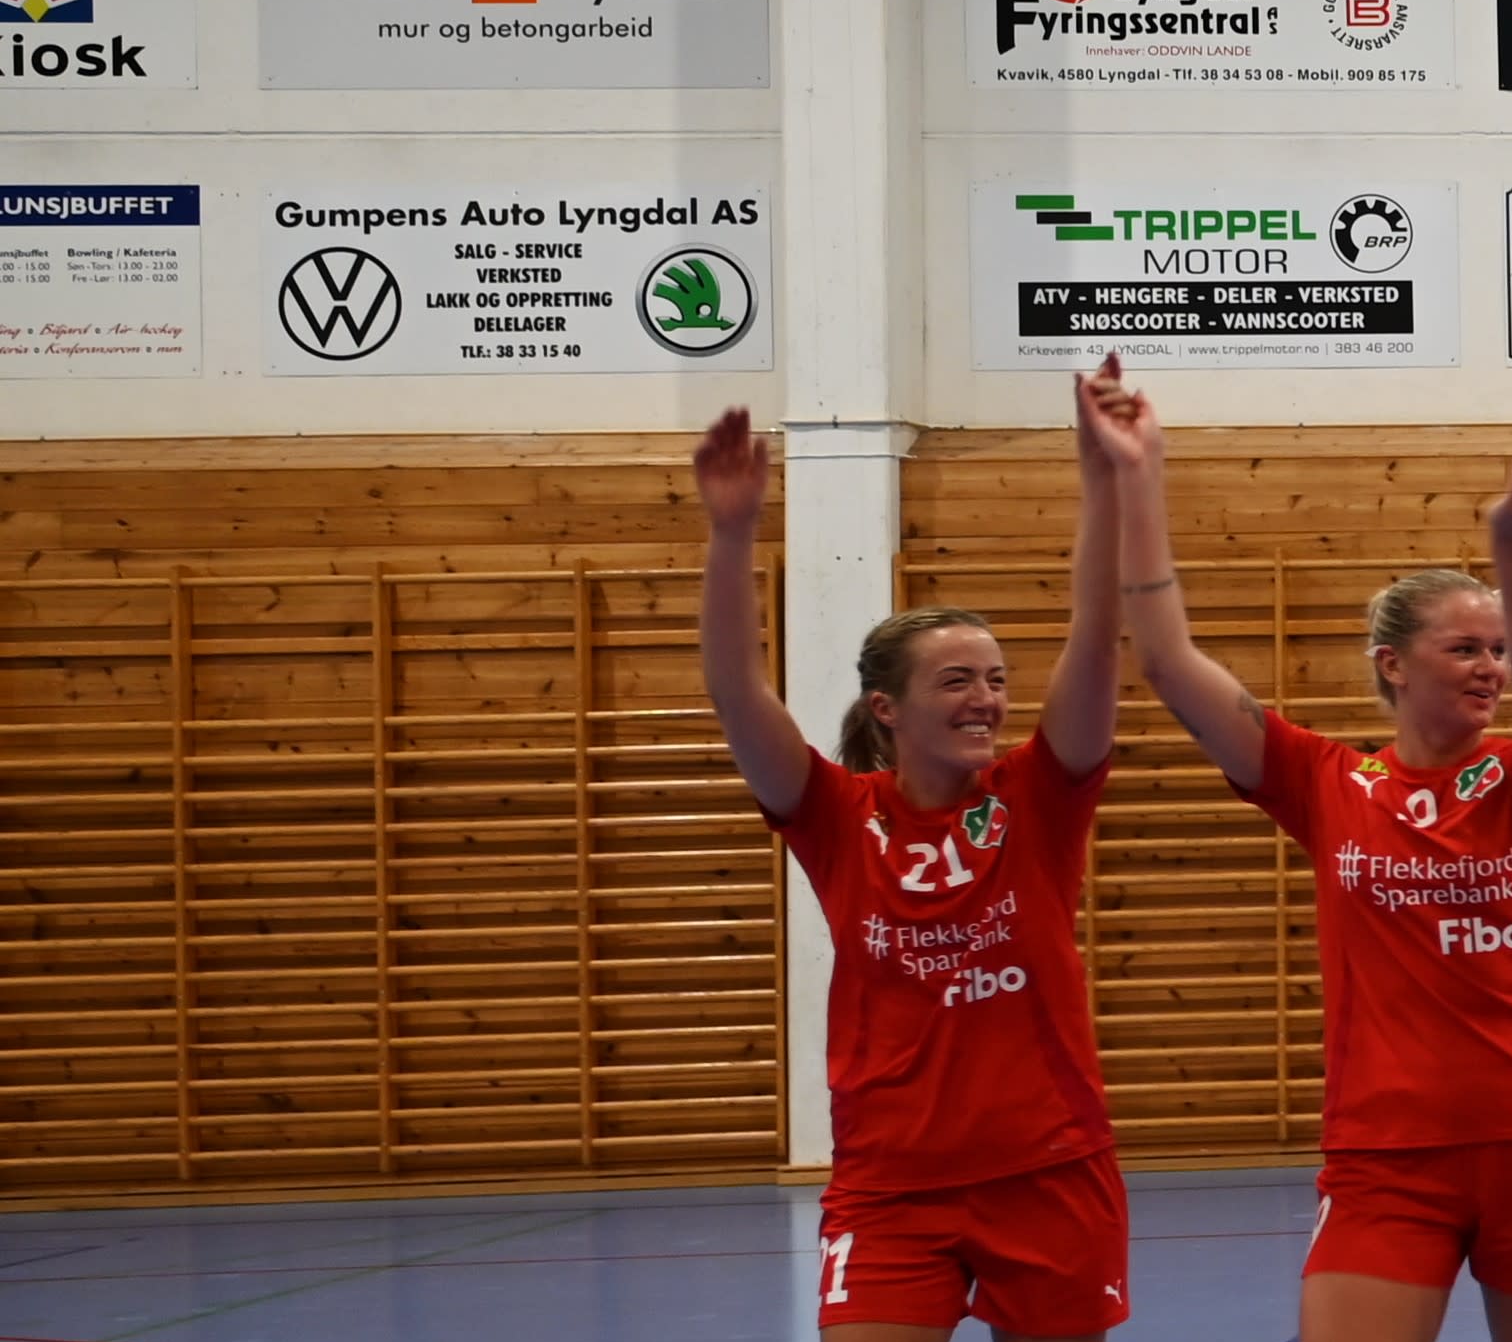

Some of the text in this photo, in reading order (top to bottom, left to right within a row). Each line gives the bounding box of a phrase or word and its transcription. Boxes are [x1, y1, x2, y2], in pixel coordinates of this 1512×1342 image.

[378, 16, 653, 44] mur og betongarbeid
[1086, 45, 1252, 57] Innehaver: ODDVIN LANDE
[997, 68, 1054, 83] Kvavik,
[1058, 68, 1094, 80] 4580
[1098, 68, 1160, 84] Lyngdal
[1172, 68, 1198, 80] Tlf.
[1200, 69, 1219, 81] 38
[1223, 69, 1240, 81] 34
[1245, 69, 1262, 81] 53
[1265, 69, 1284, 81] 08
[1347, 69, 1375, 82] 909
[1378, 69, 1395, 82] 85
[1401, 70, 1426, 82] 175
[275, 198, 759, 234] Gumpens Auto Lyngdal AS
[1113, 210, 1317, 240] TRIPPEL
[1364, 236, 1408, 248] BRP
[454, 243, 583, 259] SALG SERVICE
[1144, 249, 1288, 274] MOTOR
[476, 268, 562, 283] VERKSTED
[426, 291, 613, 308] LAKK OG OPPRETTING
[1033, 286, 1399, 305] ATV HENGERE DELER VERKSTED
[474, 317, 566, 332] DELELAGER
[1070, 312, 1365, 331] SNØSCOOTER VANNSCOOTER
[496, 345, 514, 358] 38
[519, 345, 536, 357] 33
[543, 345, 558, 357] 15
[563, 345, 581, 357] 40
[1018, 344, 1082, 356] Kirkeveien
[1188, 344, 1320, 357] www.trippelmotor.no
[1334, 343, 1361, 354] 383
[1365, 343, 1383, 354] 46
[1388, 342, 1414, 353] 200
[901, 834, 975, 892] 21
